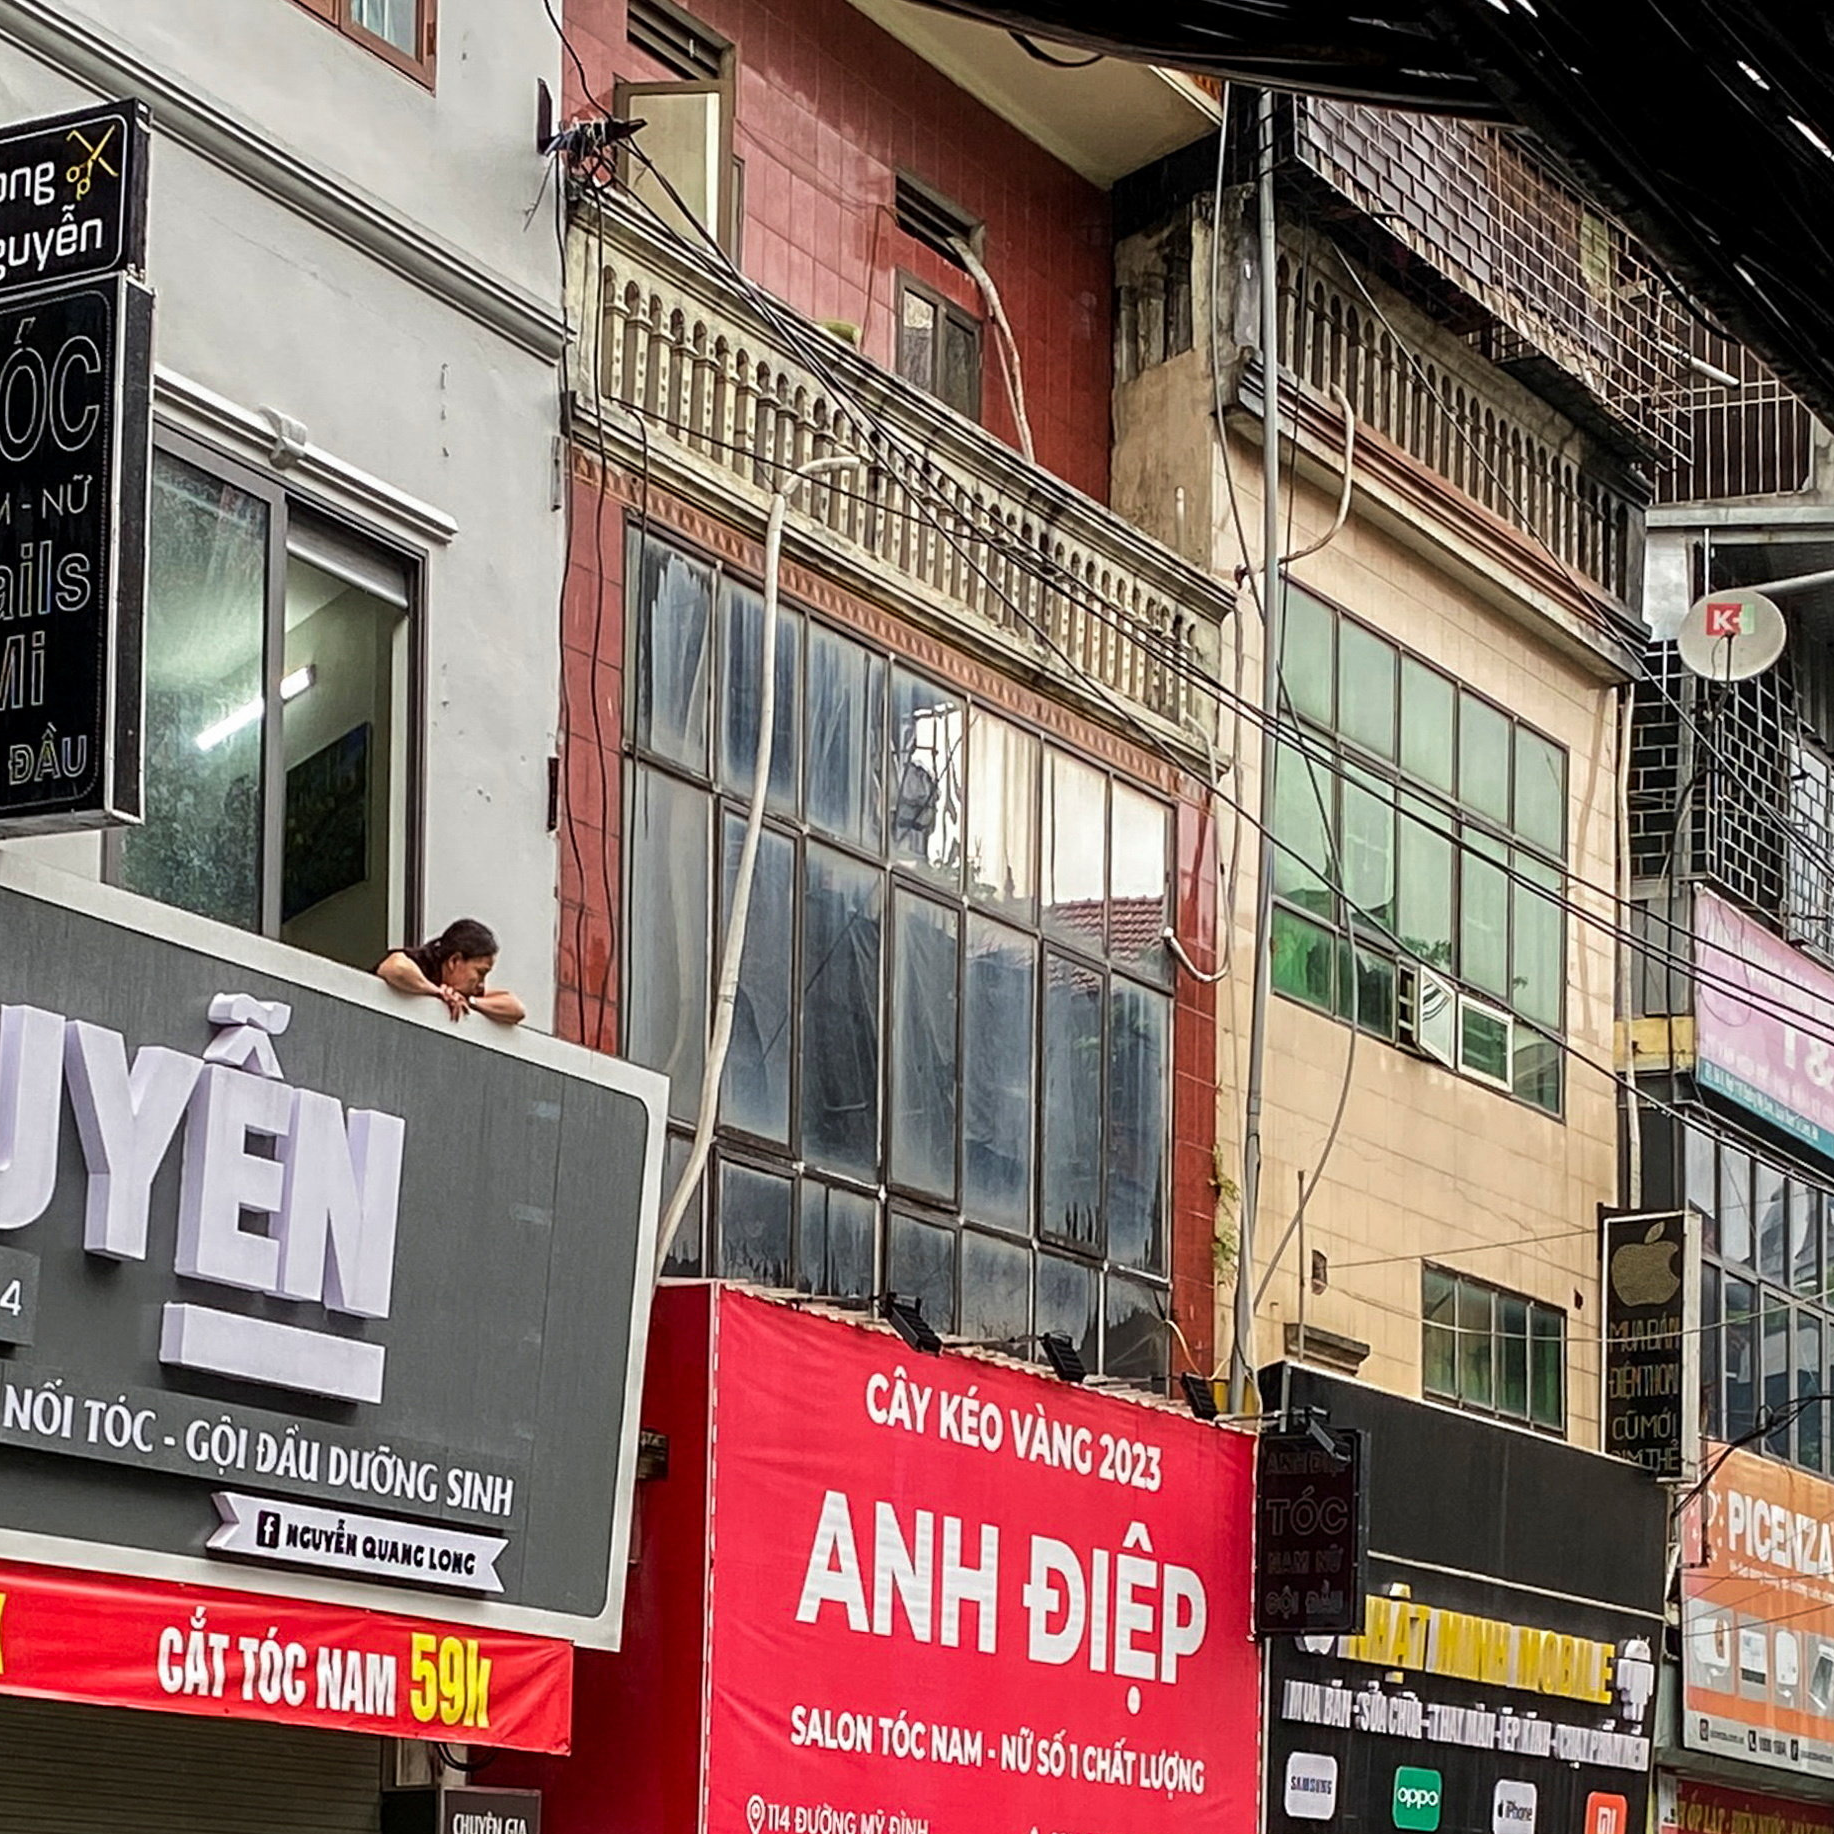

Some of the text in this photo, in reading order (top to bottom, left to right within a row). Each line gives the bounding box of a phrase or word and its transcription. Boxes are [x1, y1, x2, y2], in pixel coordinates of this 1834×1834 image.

[41, 475, 93, 518] NỮ
[8, 722, 88, 784] ĐẦU
[2, 1378, 73, 1439] NỐI
[83, 1395, 156, 1453] TÓC
[185, 1416, 247, 1476] GỘI
[256, 1424, 320, 1482] ĐẦU
[327, 1445, 439, 1504] DƯỠNG
[446, 1468, 515, 1517] SINH
[866, 1365, 1163, 1493] CÂY KÉO VÀNG 2023
[286, 1519, 476, 1576] NGUYỄN QUANG LONG
[1266, 1484, 1348, 1536] TÓC
[1728, 1489, 1834, 1582] PICENZA
[795, 1489, 1208, 1715] ANH ĐIỆP
[157, 1606, 493, 1729] CẮT TÓC NAM 59k
[789, 1705, 1205, 1800] SALON TÓC NAM NỮ SỐ 1 CHẤT LƯỢNG
[767, 1804, 791, 1833] 114
[1397, 1786, 1439, 1808] oppo
